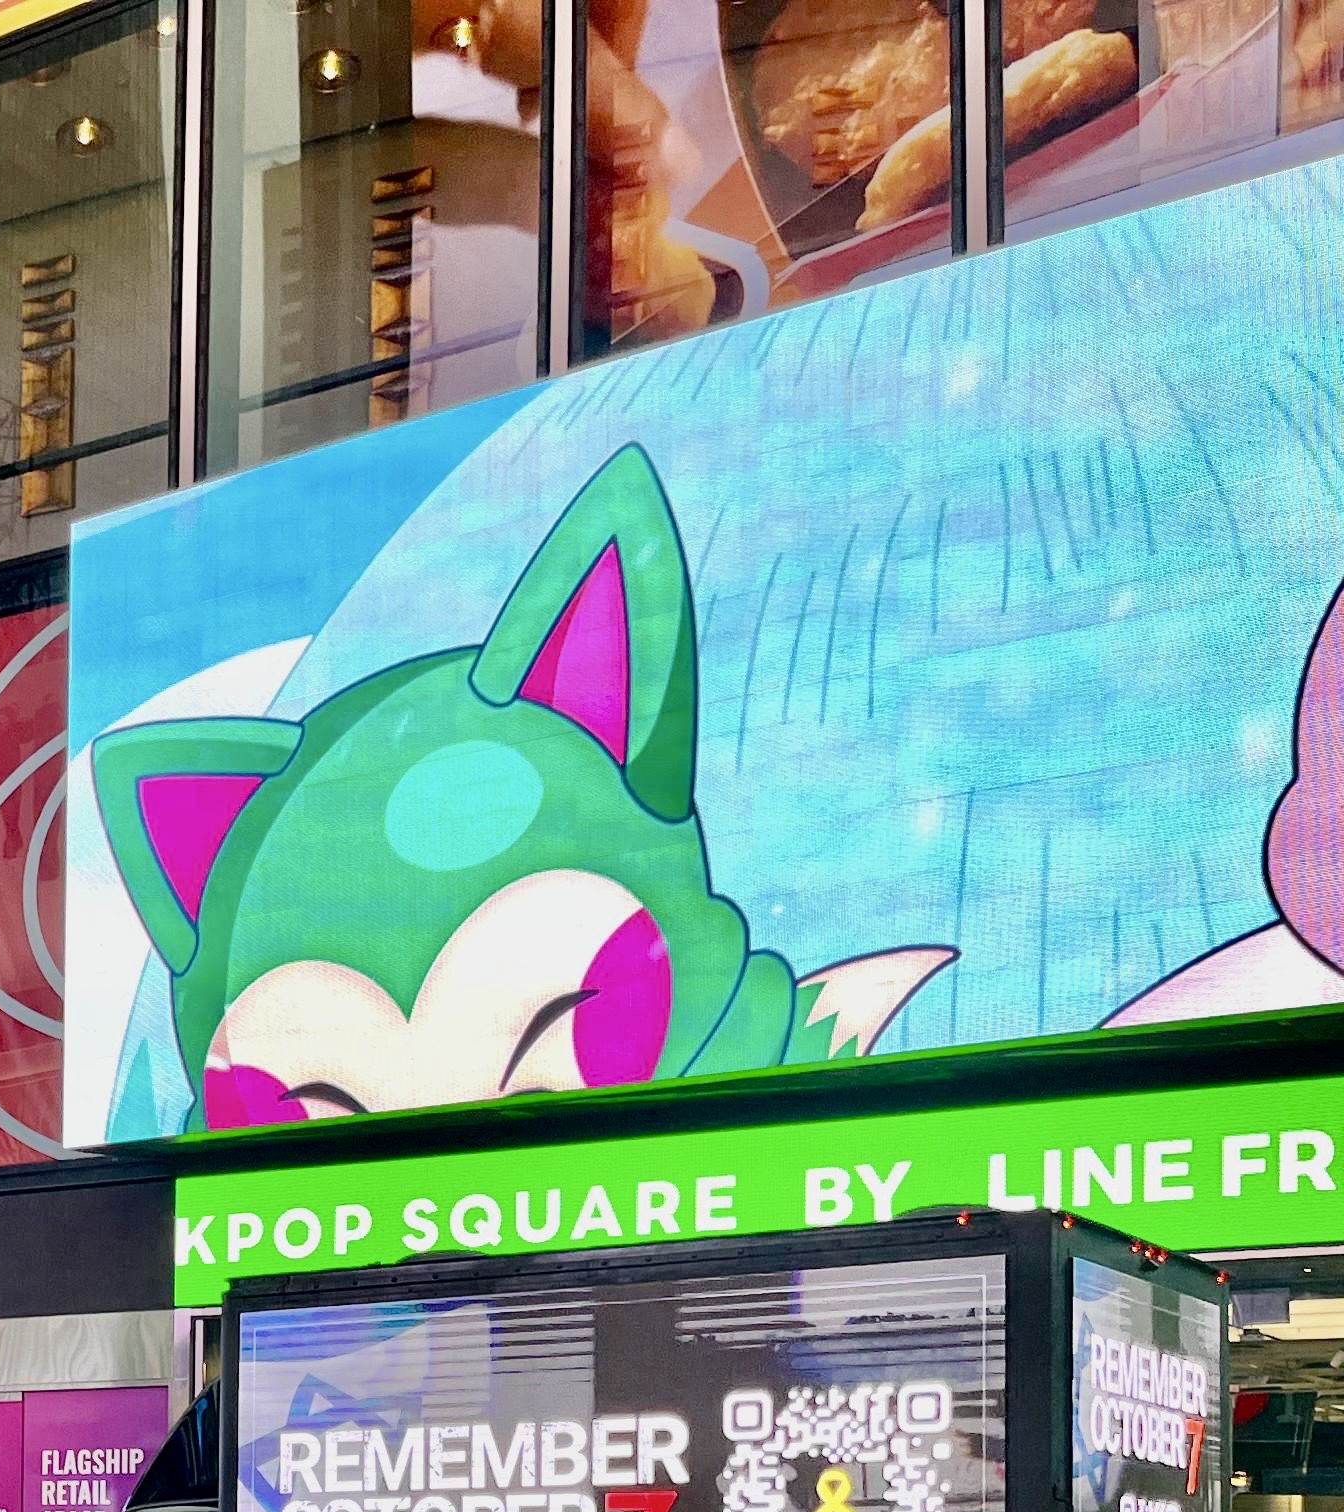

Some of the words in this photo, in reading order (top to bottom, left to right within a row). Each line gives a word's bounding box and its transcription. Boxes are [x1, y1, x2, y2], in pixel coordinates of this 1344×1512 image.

[175, 1202, 373, 1267] KPOP
[400, 1175, 737, 1255] SQUARE
[806, 1161, 912, 1227] BY
[988, 1138, 1194, 1213] LINE
[1222, 1129, 1337, 1197] FR
[1089, 1334, 1208, 1418] REMEMBER
[41, 1448, 144, 1475] FLAGSHIP
[278, 1412, 691, 1495] REMEMBER
[1089, 1396, 1188, 1469] OCTOBER
[1185, 1418, 1204, 1496] 7
[41, 1479, 111, 1505] RETAIL
